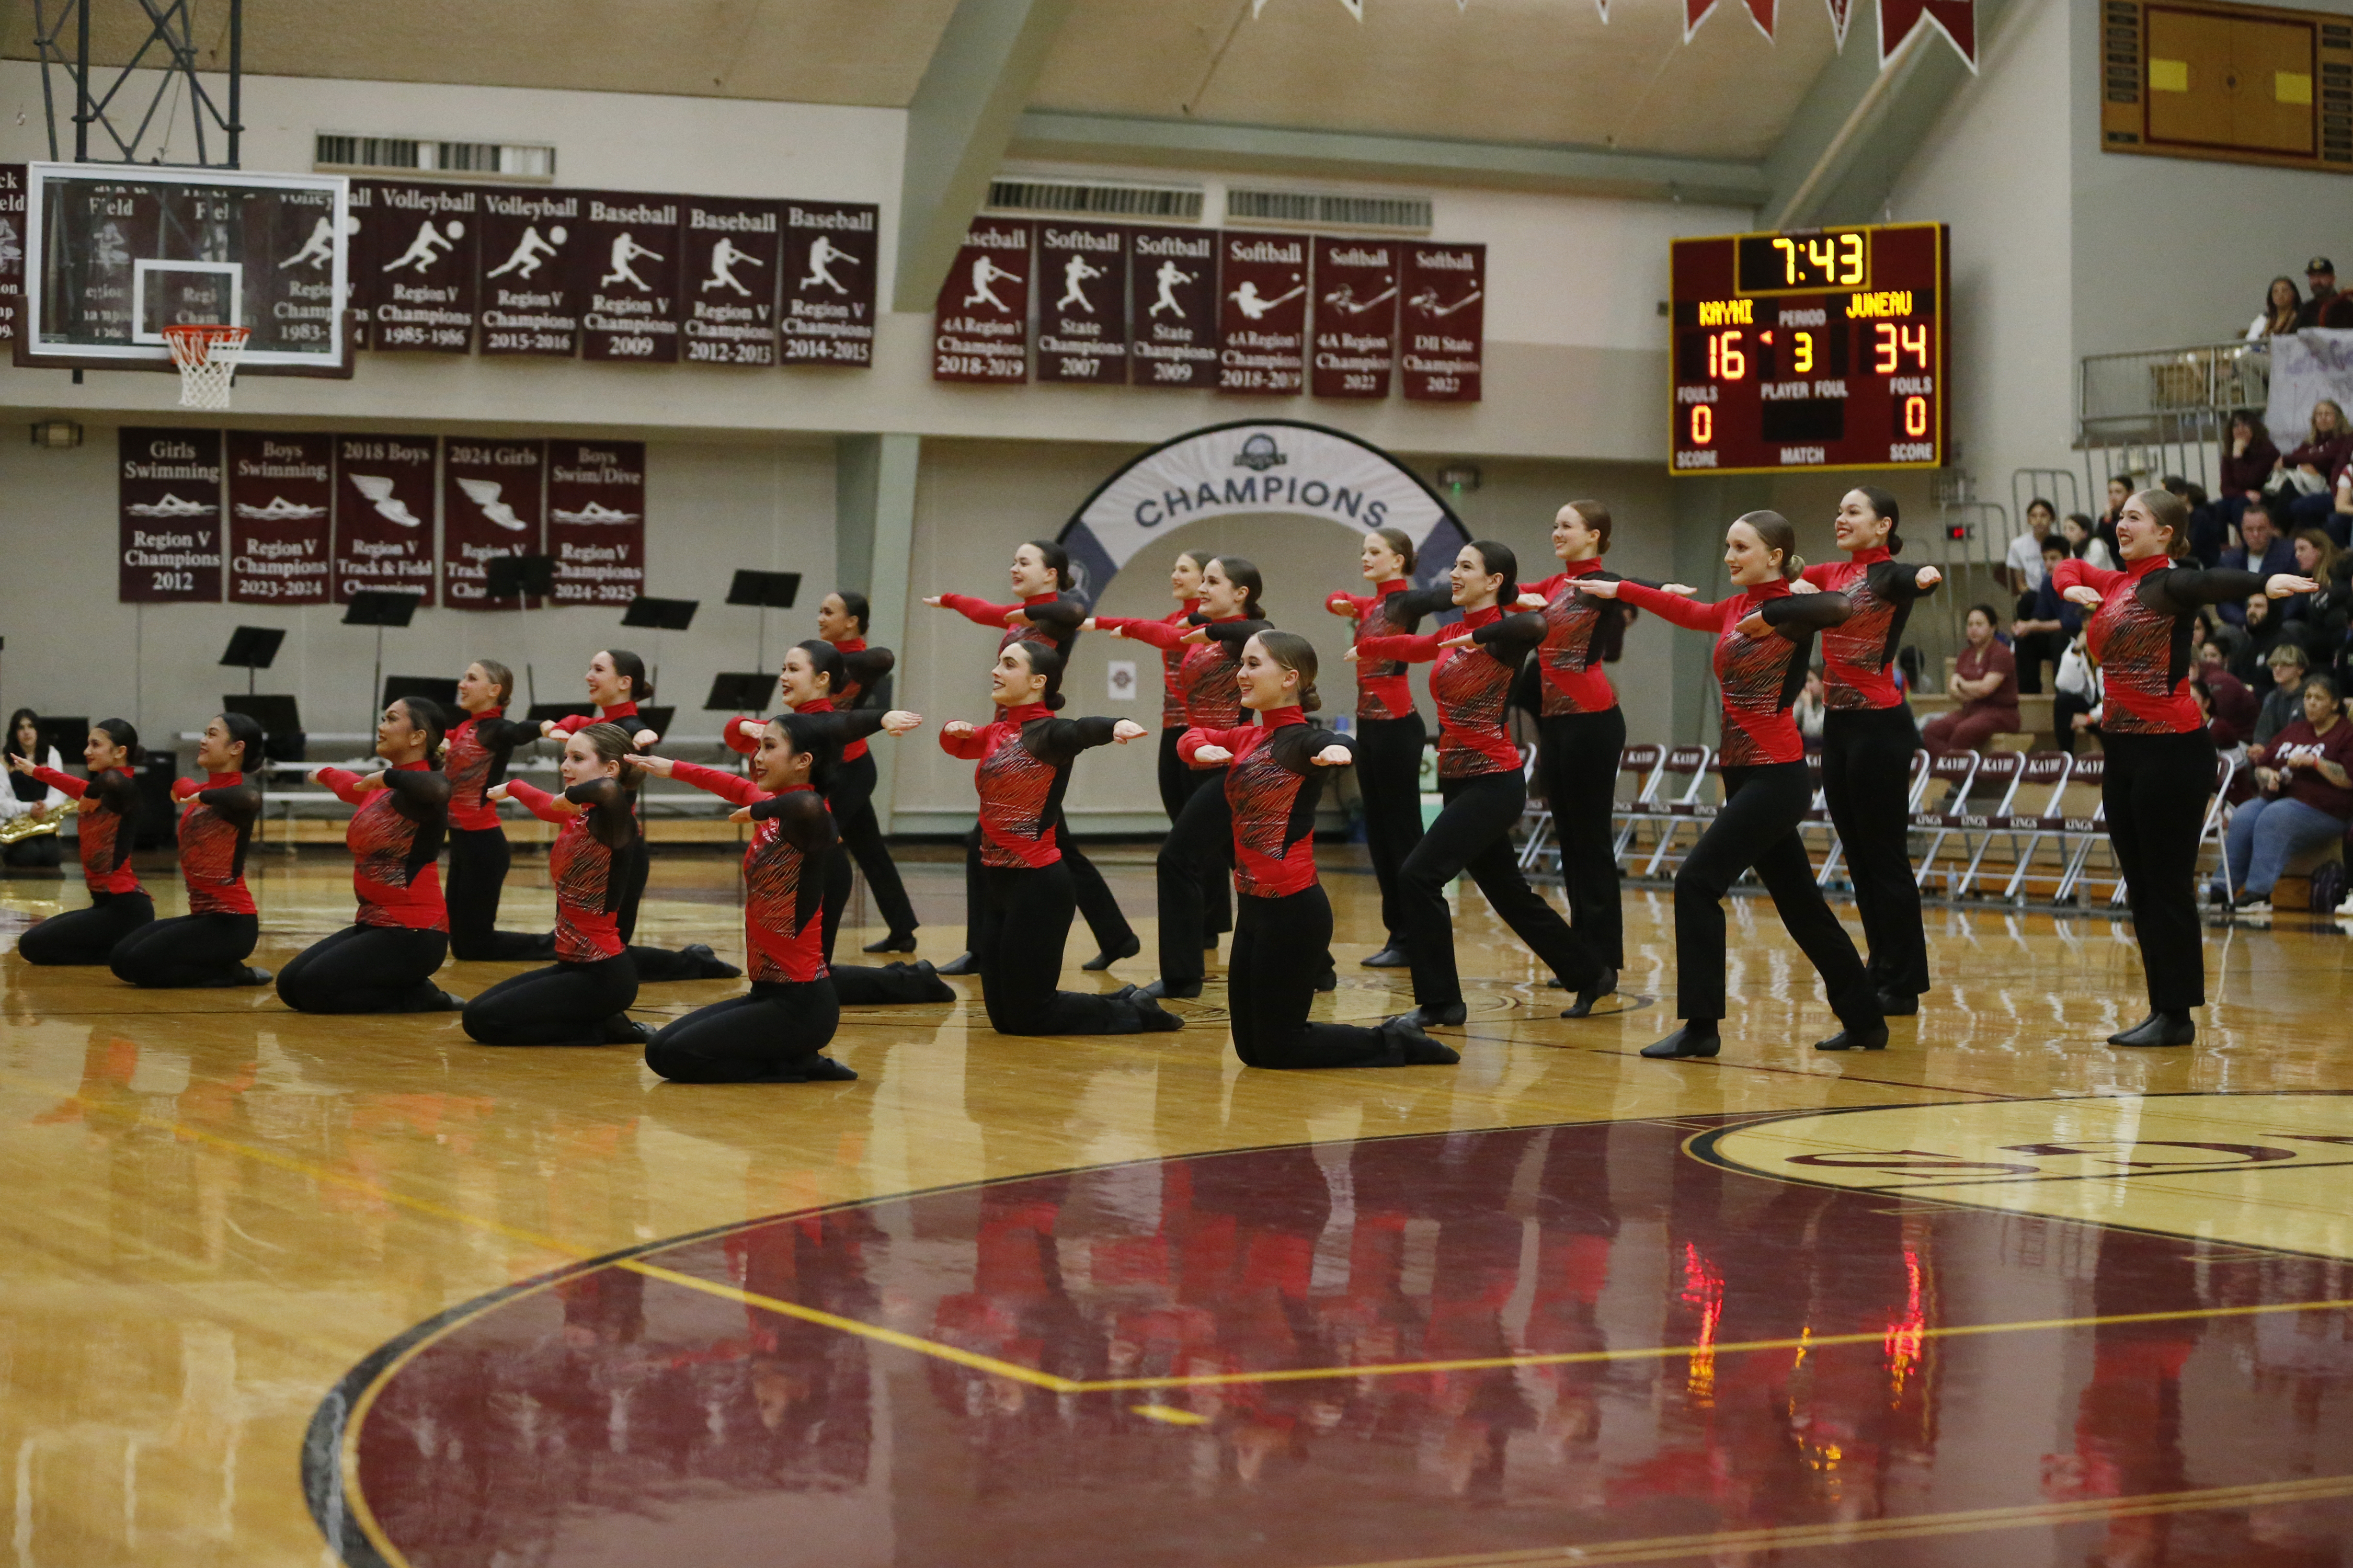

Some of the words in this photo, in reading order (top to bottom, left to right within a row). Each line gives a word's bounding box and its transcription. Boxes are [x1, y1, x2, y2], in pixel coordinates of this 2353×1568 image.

[382, 187, 475, 214] Volleyball
[485, 194, 578, 220] Volleyball
[590, 201, 677, 225] Baseball
[691, 208, 776, 232] Baseball
[789, 207, 873, 231] Baseball
[1045, 228, 1120, 252] Softball
[1136, 234, 1210, 258] Softball
[1230, 241, 1302, 262] Softball
[1329, 247, 1389, 267] Softball
[1417, 251, 1475, 270] Softball
[1773, 234, 1864, 284] 7:43
[393, 283, 446, 303] Region
[446, 287, 459, 302] V
[498, 290, 550, 310] Region
[551, 291, 563, 307] V
[378, 304, 471, 325] Champions
[592, 294, 653, 315] Region
[657, 297, 669, 314] V
[694, 301, 753, 322] Region
[757, 304, 769, 321] V
[791, 299, 849, 319] Region
[852, 302, 865, 318] V
[1846, 291, 1912, 318] JUNEAU
[482, 311, 575, 330] Champions
[584, 313, 677, 335] Champions
[782, 317, 872, 338] Champions
[965, 317, 1014, 337] Region
[1060, 318, 1101, 335] State
[1779, 309, 1826, 328] PERIOD
[384, 327, 465, 346] 1985-1986
[684, 319, 774, 341] Champions
[1153, 323, 1193, 341] State
[1248, 331, 1295, 350] Region
[488, 333, 570, 349] 2015-2016
[609, 336, 654, 356] 2009
[786, 339, 869, 361] 2014-2015
[937, 336, 1025, 358] Champions
[1039, 335, 1125, 357] Champions
[1134, 341, 1216, 361] Champions
[1342, 333, 1388, 352] Region
[1875, 323, 1927, 373] 34
[688, 341, 772, 364] 2012-2013
[1221, 349, 1301, 370] Champions
[1316, 352, 1393, 372] Champions
[1709, 330, 1745, 380] 16
[1794, 332, 1813, 372] 3
[937, 355, 1024, 376] 2018-2019
[1402, 354, 1480, 375] Champions
[1677, 386, 1718, 405] FOULS
[1761, 381, 1810, 400] PLAYER
[1814, 380, 1849, 398] FOUL
[1890, 376, 1932, 395] FOULS
[1691, 405, 1712, 444] 0
[1905, 396, 1927, 436] 0
[150, 440, 196, 460] Girls
[263, 440, 303, 462] Boys
[343, 442, 384, 460] 2018
[389, 443, 430, 466] Boys
[450, 446, 491, 464] 2024
[494, 448, 538, 465] Girls
[578, 447, 617, 470] Boys
[1676, 450, 1718, 468] SCORE
[1780, 447, 1825, 464] MATCH
[1890, 443, 1933, 461] SCORE
[124, 460, 220, 484] Swimming
[238, 460, 328, 483] Swimming
[552, 466, 641, 485] Swim/Dive
[1134, 475, 1389, 529] CHAMPIONS
[134, 530, 192, 551] Region
[197, 530, 211, 547] V
[246, 537, 303, 559] Region
[303, 538, 318, 555] V
[352, 539, 404, 559] Region
[406, 540, 418, 555] V
[124, 550, 221, 570] Champions
[462, 542, 510, 562] Region
[512, 543, 526, 557] V
[561, 542, 615, 563] Region
[616, 544, 629, 560] V
[233, 556, 328, 578] Champions
[337, 558, 380, 576] Track
[382, 560, 395, 575] &
[398, 560, 432, 576] Field
[446, 561, 487, 578] Track
[153, 571, 193, 591] 2012
[239, 579, 323, 598] 2023-2024
[555, 583, 636, 601] 2024-2025
